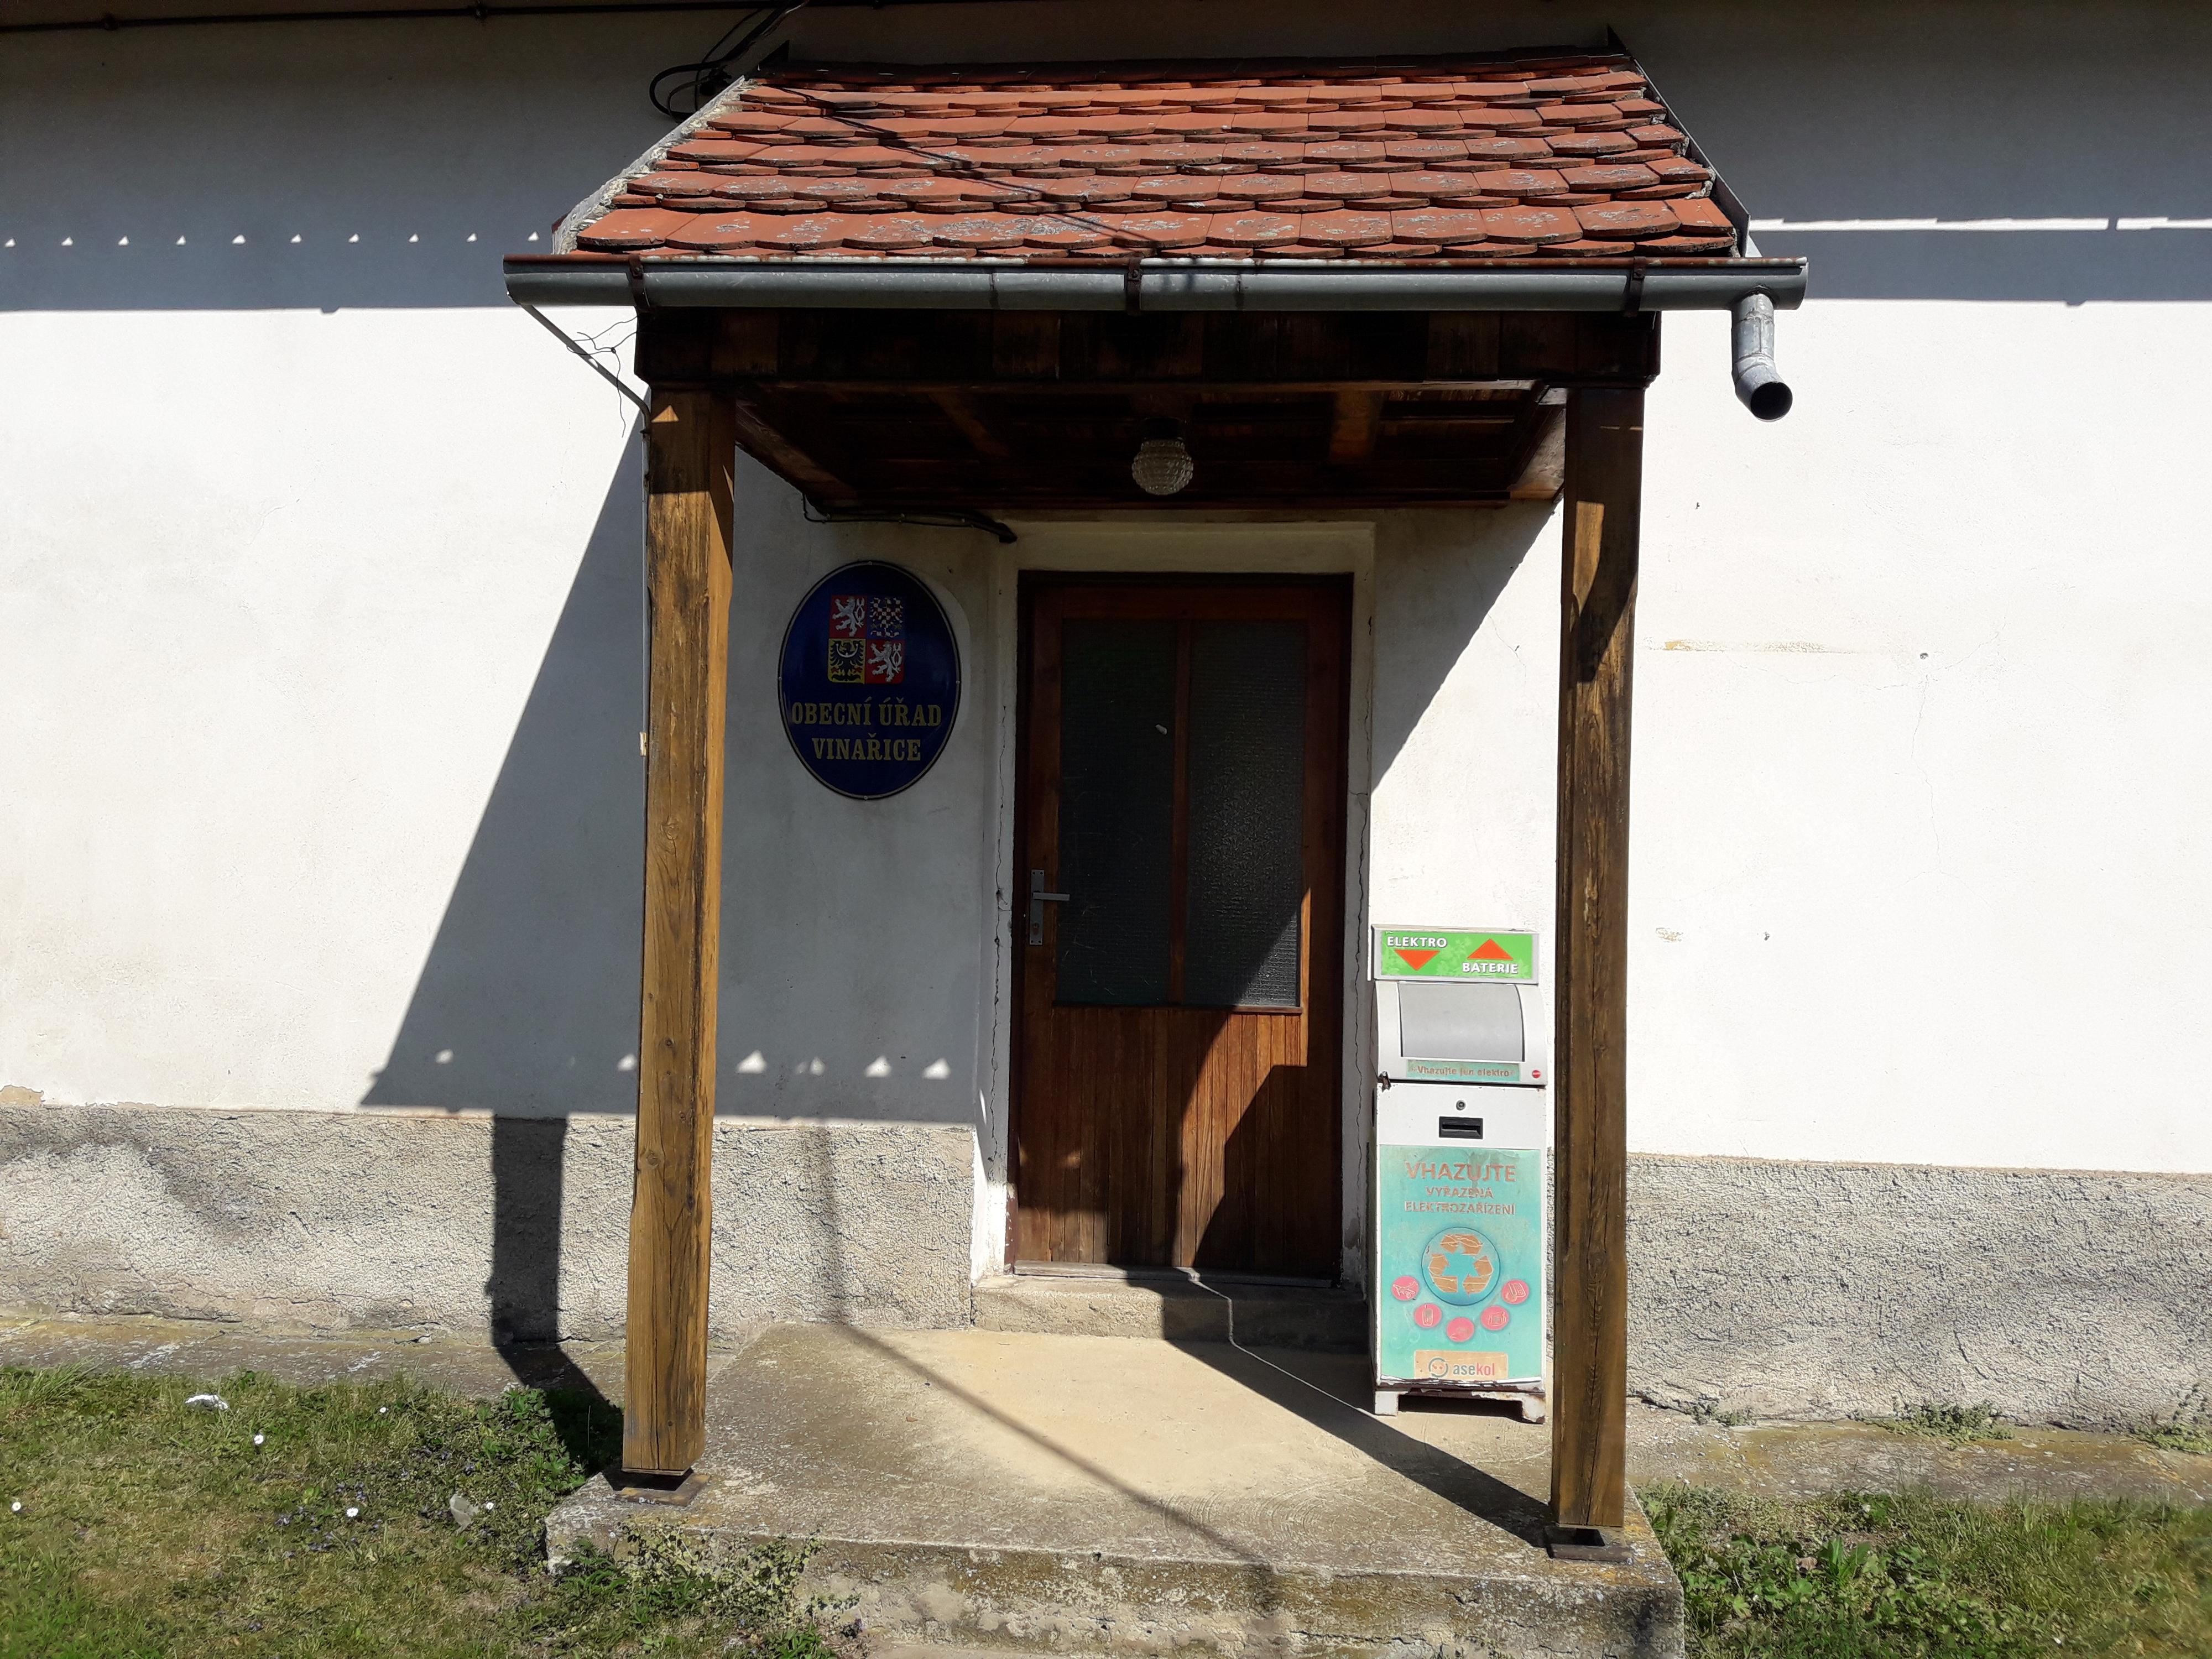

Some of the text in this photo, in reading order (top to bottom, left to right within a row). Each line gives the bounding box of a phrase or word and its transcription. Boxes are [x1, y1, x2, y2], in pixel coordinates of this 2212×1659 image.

[792, 696, 941, 727] OBECNÍ ÚŘAD
[811, 732, 921, 761] VINAŘICE
[1387, 936, 1447, 948] ELEKTRO
[1462, 962, 1519, 974] BATERIE
[1405, 1162, 1517, 1182] VHAZUJTE
[1425, 1186, 1494, 1199] VYŘAZENÁ
[1453, 1363, 1495, 1376] asekol
